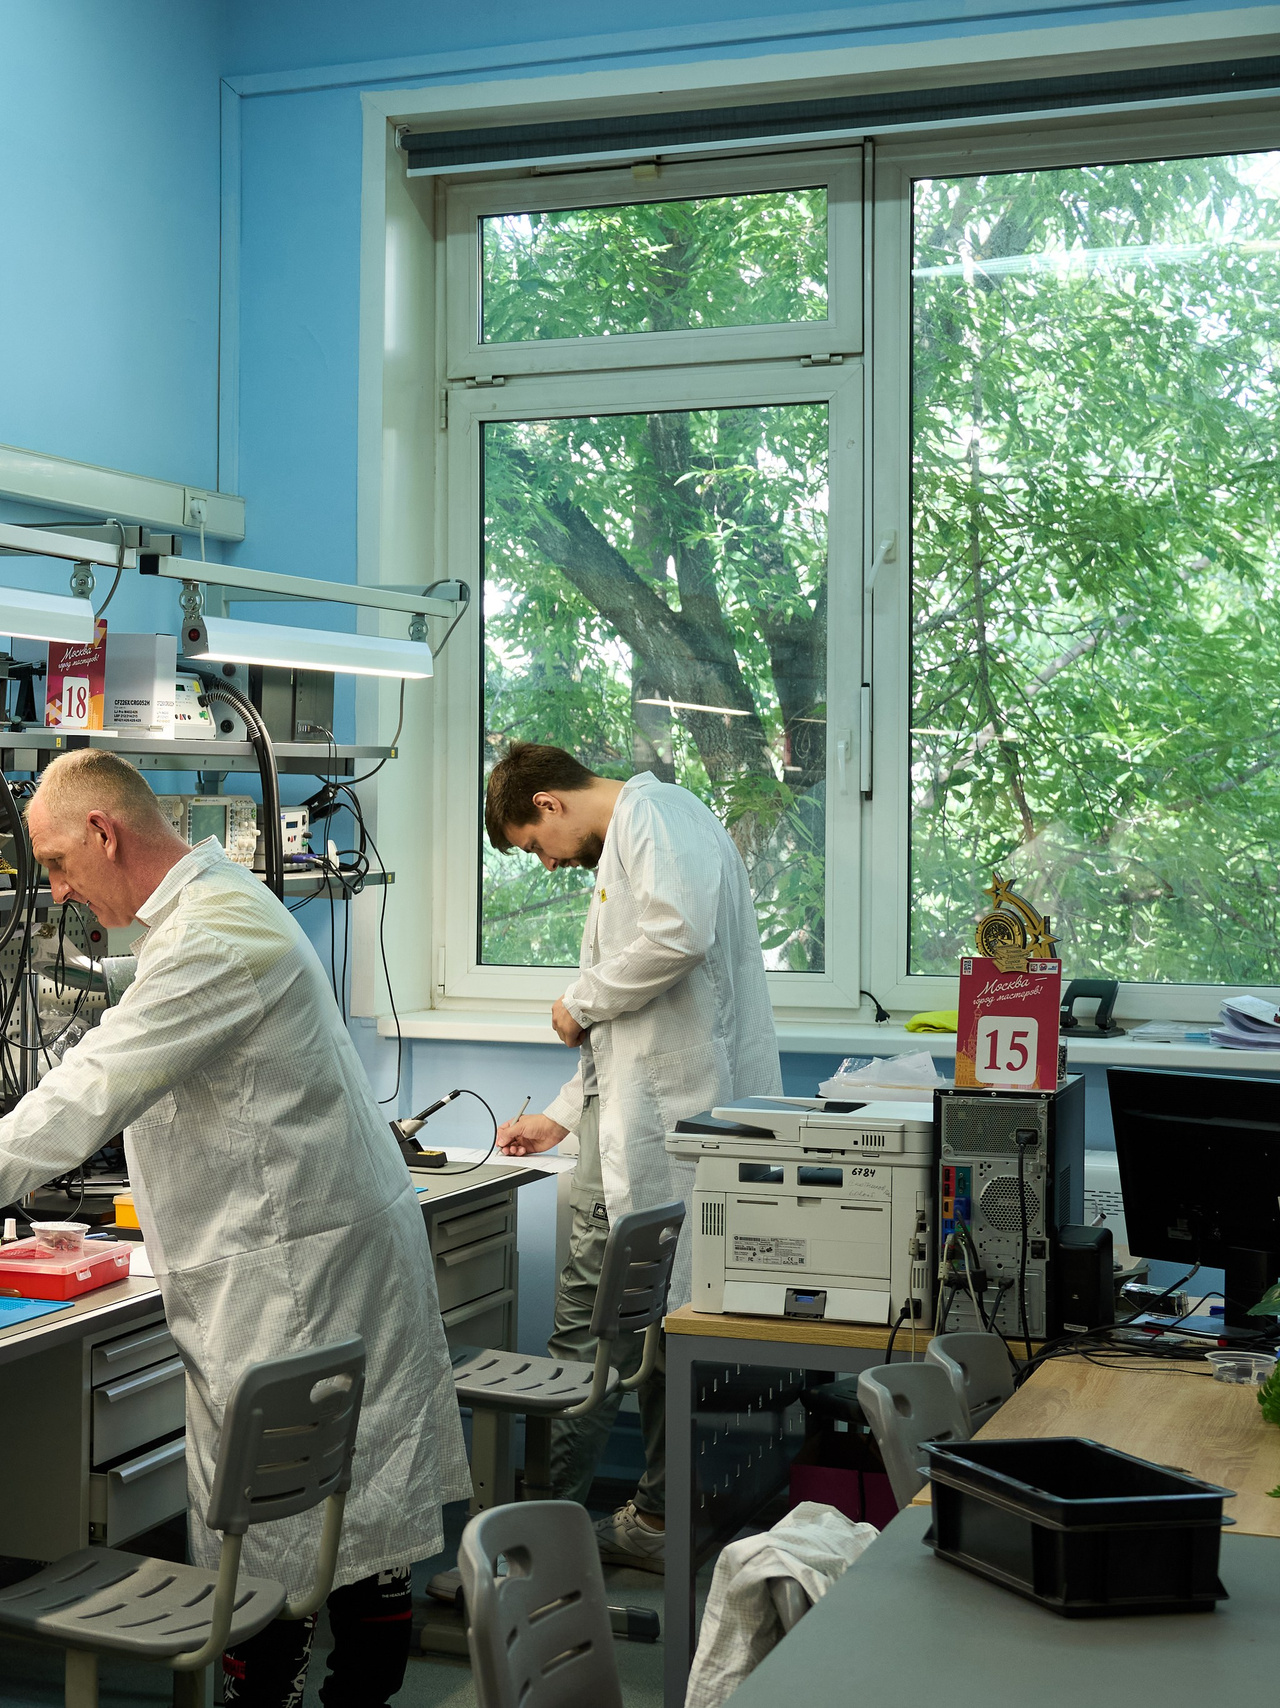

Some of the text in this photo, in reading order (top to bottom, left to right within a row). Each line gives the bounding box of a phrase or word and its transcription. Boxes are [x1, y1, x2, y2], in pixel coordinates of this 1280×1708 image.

[60, 643, 93, 662] Москва
[66, 686, 87, 719] 18
[973, 985, 1043, 1009] город мастеров!
[976, 975, 1030, 998] Москва
[984, 1029, 1029, 1072] 15
[851, 1167, 876, 1178] 6784
